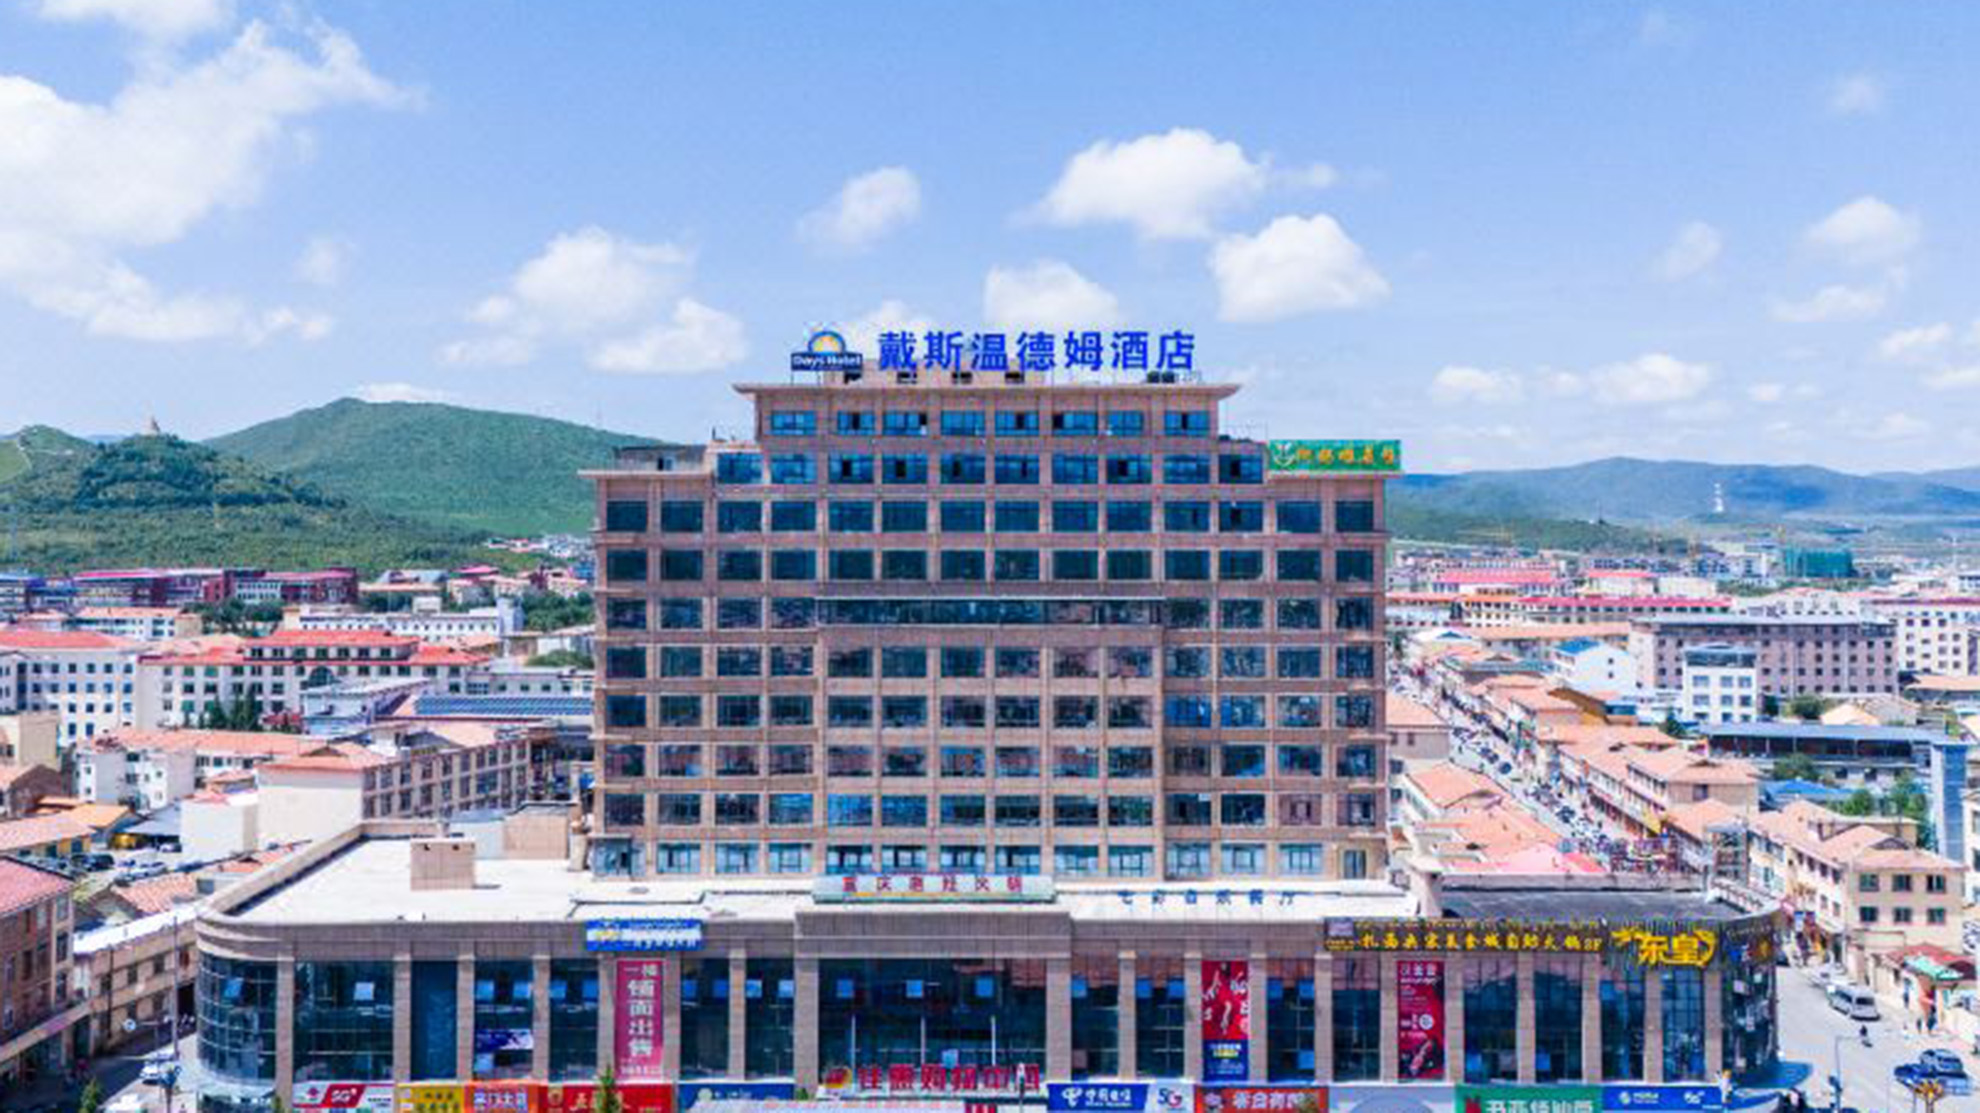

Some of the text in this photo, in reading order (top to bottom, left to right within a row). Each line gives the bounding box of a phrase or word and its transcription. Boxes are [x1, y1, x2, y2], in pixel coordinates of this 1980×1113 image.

[877, 330, 1196, 371] 戴斯温德姆酒店
[1622, 928, 1717, 967] 东皇
[627, 979, 655, 1057] 铺面出售
[1158, 1088, 1183, 1108] 5G
